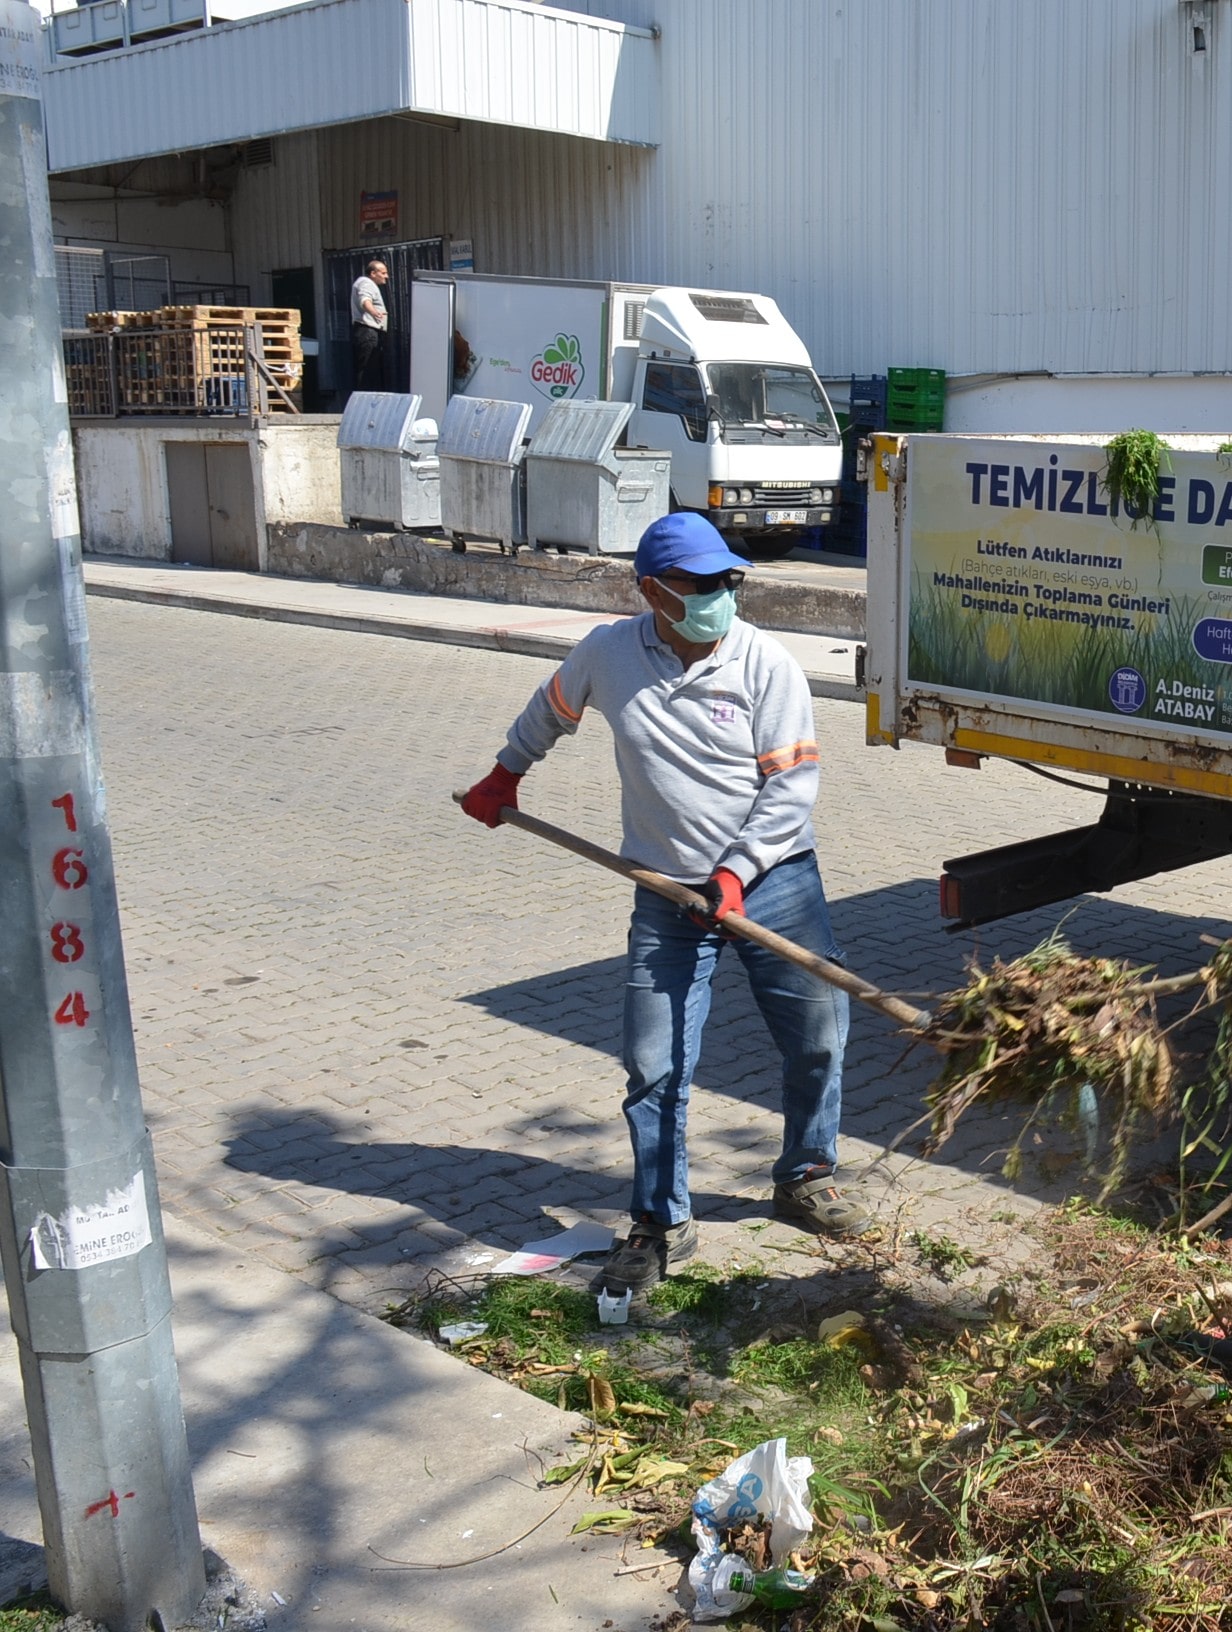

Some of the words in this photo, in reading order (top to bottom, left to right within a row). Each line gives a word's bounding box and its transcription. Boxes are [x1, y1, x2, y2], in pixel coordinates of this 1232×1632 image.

[531, 360, 578, 386] Gedik
[977, 540, 1027, 559] Lütfen
[1031, 546, 1123, 570] Atıklarınızı
[961, 558, 1003, 578] (Bahçe
[1005, 564, 1050, 583] atıkları,
[1052, 569, 1079, 584] eski
[1080, 576, 1113, 591] eşya,
[1114, 576, 1139, 594] vb.)
[933, 571, 1029, 597] Mahallenizin
[1034, 583, 1103, 608] Toplama
[1107, 593, 1171, 615] Günleri
[961, 594, 1019, 615] Dışında
[1023, 603, 1136, 631] Çıkarmayınız.
[1156, 678, 1215, 702] A.Deniz
[1154, 698, 1216, 721] ATABAY
